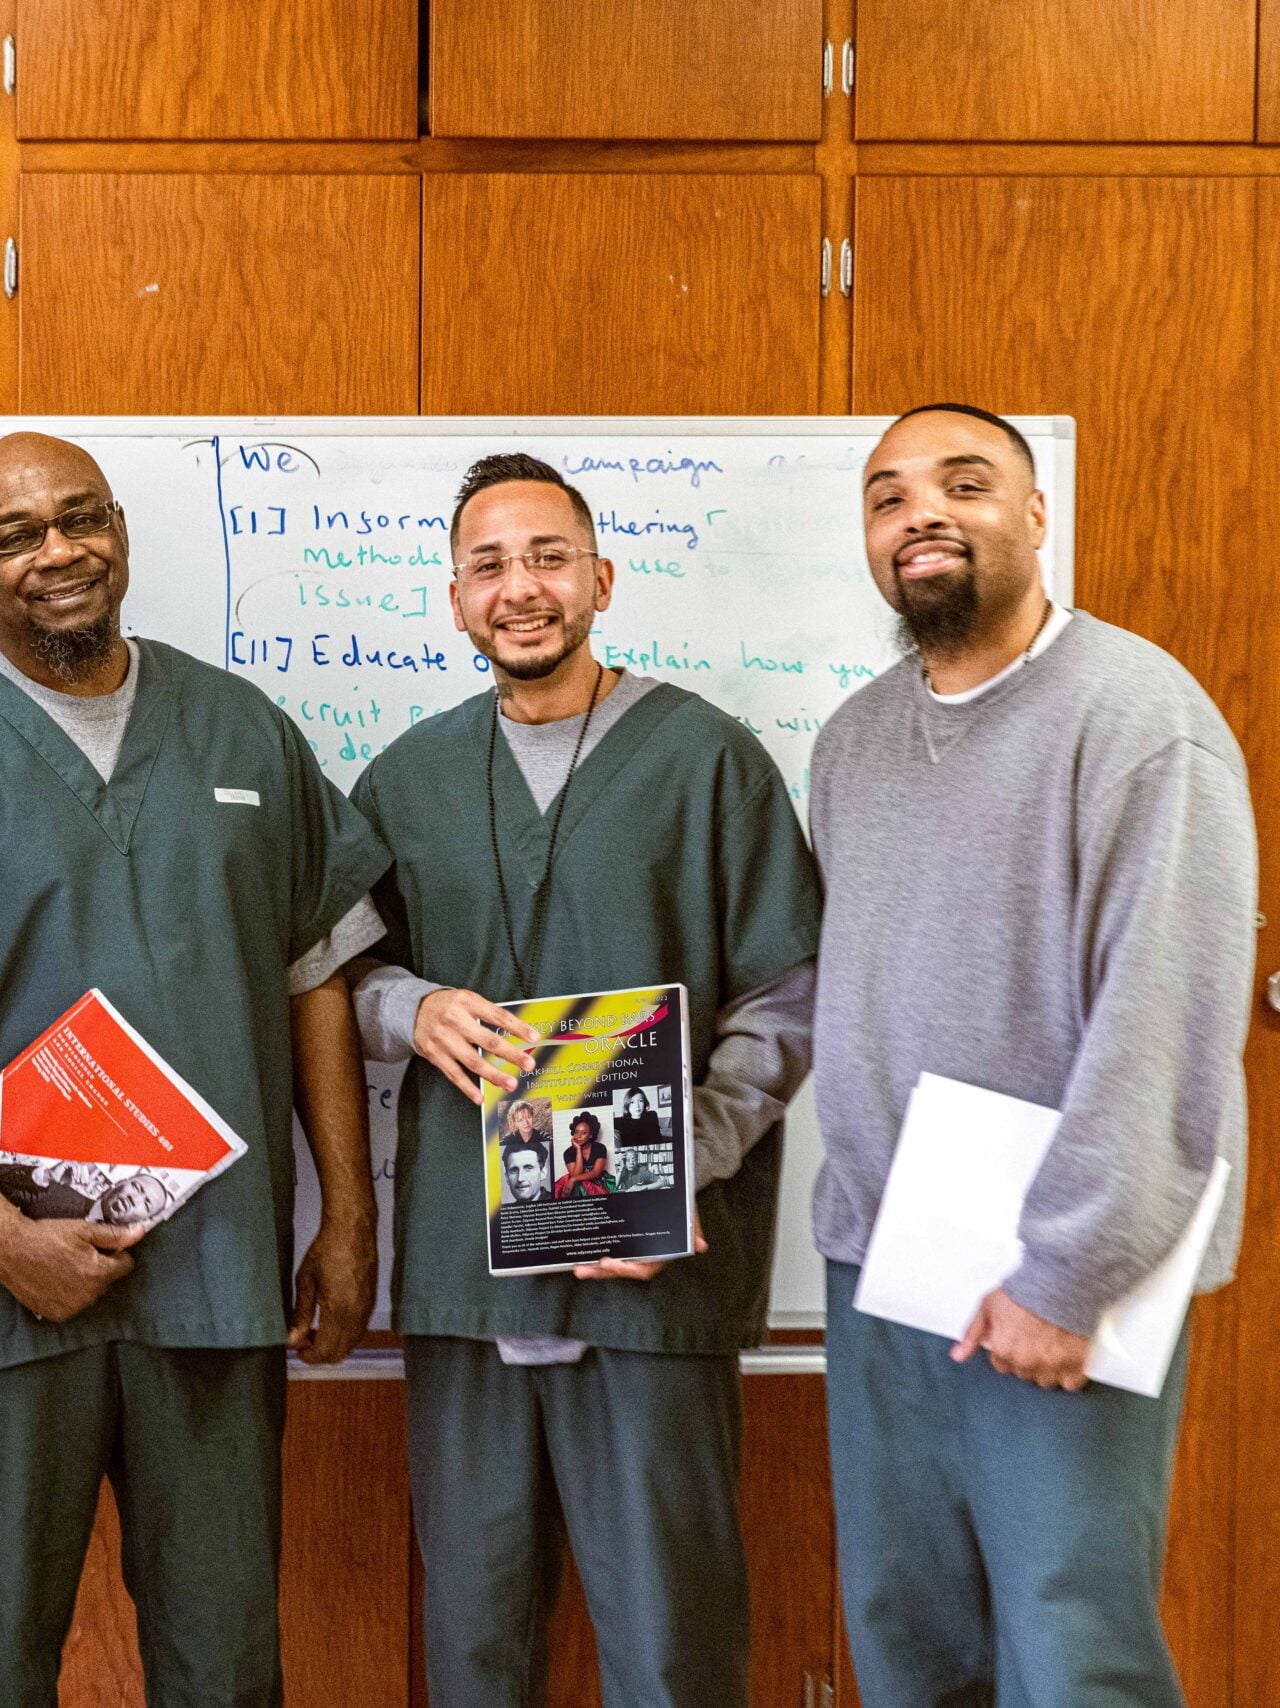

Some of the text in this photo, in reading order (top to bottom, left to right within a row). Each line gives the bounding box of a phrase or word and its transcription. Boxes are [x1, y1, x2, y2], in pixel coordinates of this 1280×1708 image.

[239, 445, 300, 473] We
[563, 449, 723, 488] campaign
[596, 510, 699, 549] thering
[629, 559, 686, 578] use
[312, 634, 447, 673] Educate
[605, 640, 712, 671] Explain
[741, 640, 803, 674] how
[560, 1015, 617, 1031] BEYOND
[622, 1009, 655, 1025] BARS
[584, 1031, 658, 1053] ORACLE
[63, 1026, 125, 1101] INTERNATIONAL
[123, 1098, 160, 1137] STUDIES
[595, 1070, 638, 1083] EDITION
